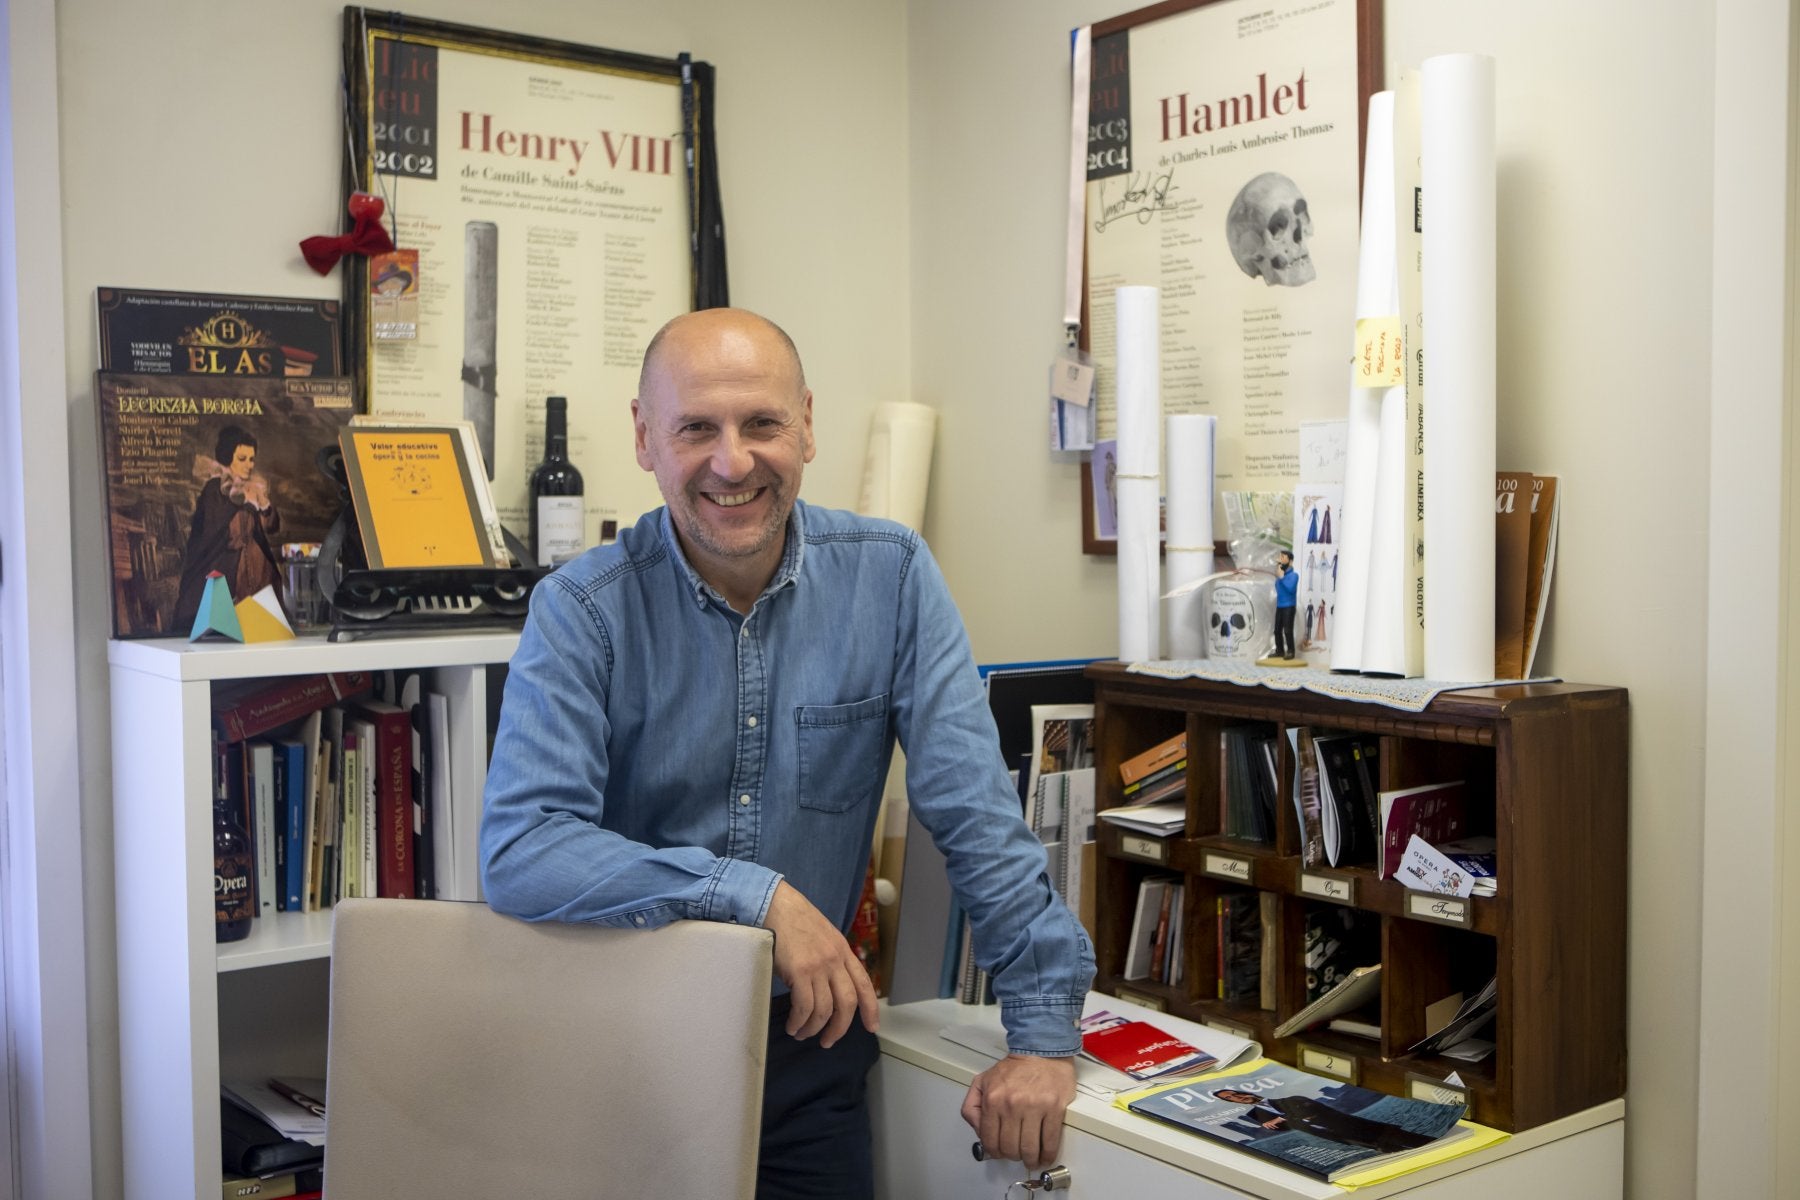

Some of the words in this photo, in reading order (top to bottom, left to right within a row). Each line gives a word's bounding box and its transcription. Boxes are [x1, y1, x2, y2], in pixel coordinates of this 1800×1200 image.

[1158, 67, 1311, 143] Hamlet
[374, 121, 431, 146] 2001
[1088, 118, 1128, 143] 2003
[458, 111, 589, 177] Henry
[598, 129, 676, 176] VIII
[1159, 156, 1171, 167] de
[1171, 148, 1208, 165] Charles
[1210, 141, 1240, 157] Louis
[1240, 131, 1290, 151] Ambroise
[1290, 121, 1336, 141] Thomas
[374, 149, 434, 176] 2002
[1087, 146, 1129, 171] 2004
[461, 164, 478, 179] de
[482, 165, 538, 186] Camille
[543, 174, 625, 196] Saint-Saëns
[222, 322, 235, 339] H
[187, 347, 226, 374] EL
[233, 349, 272, 375] AS
[118, 397, 199, 414] LUCREZIA
[202, 398, 263, 416] BORGIA
[370, 442, 393, 451] Valor
[397, 442, 439, 451] educativo
[1497, 479, 1518, 492] 100
[1416, 577, 1424, 618] VOLOTEA
[390, 746, 403, 793] ESPAÑA
[392, 806, 407, 861] CORONA
[1413, 851, 1438, 872] OPERA
[1326, 1057, 1333, 1069] 2
